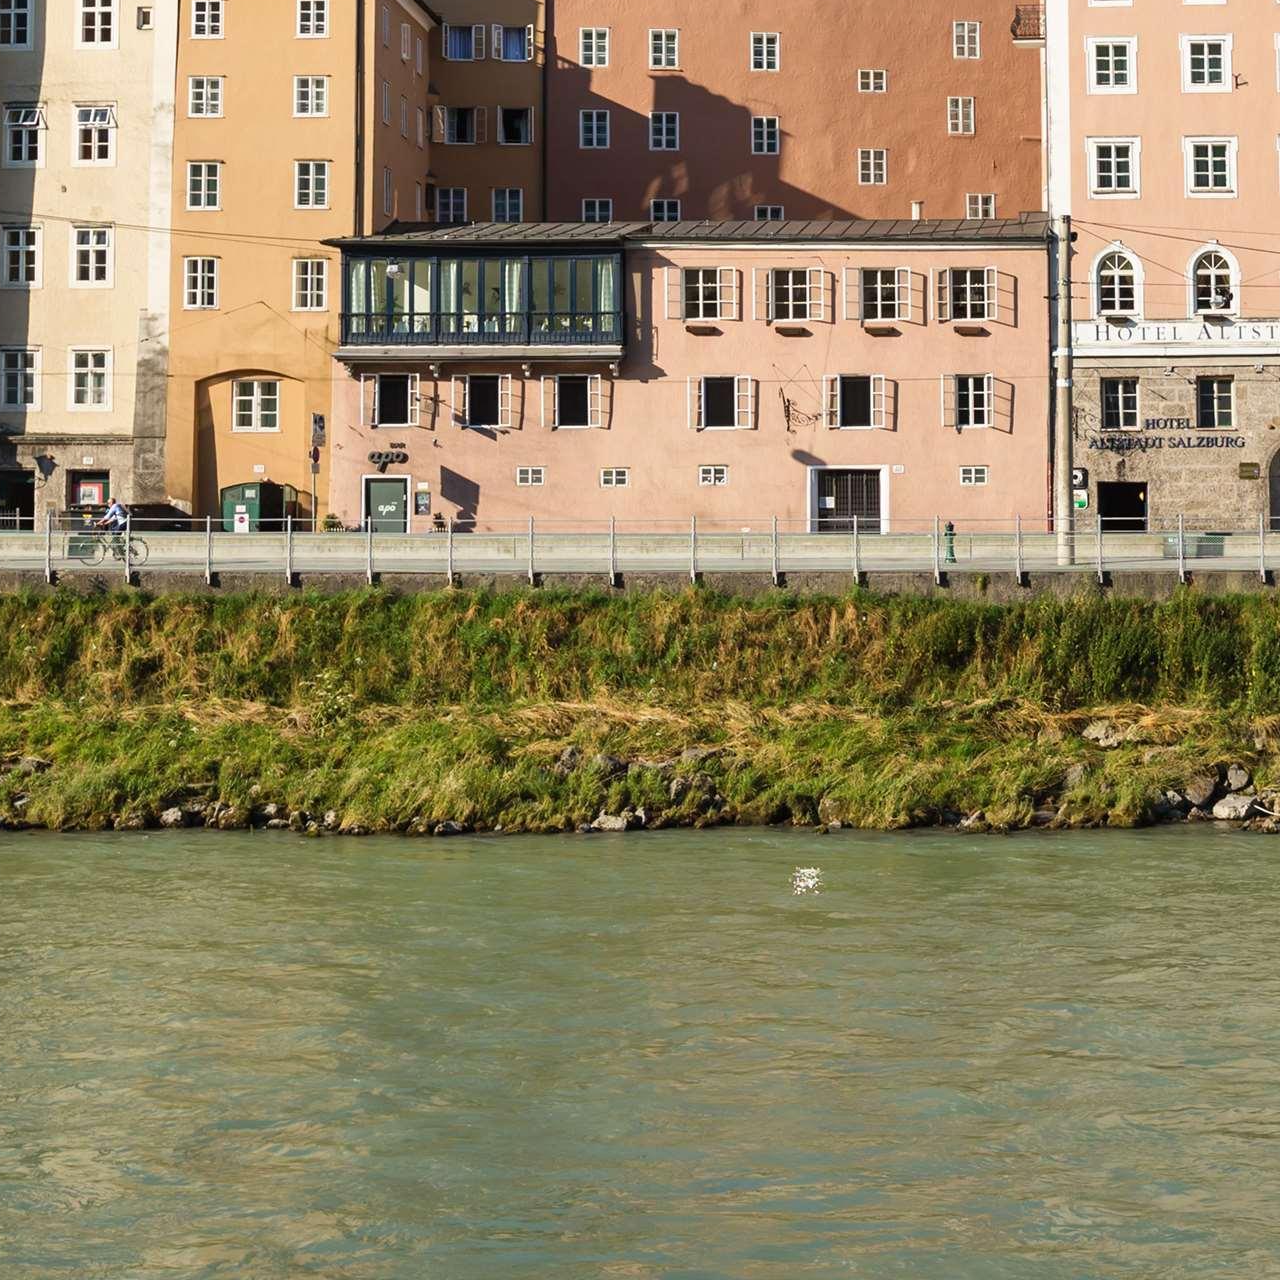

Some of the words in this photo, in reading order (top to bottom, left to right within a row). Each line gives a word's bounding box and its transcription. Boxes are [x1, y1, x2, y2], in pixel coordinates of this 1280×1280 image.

[1095, 324, 1182, 341] HOTEL
[1145, 418, 1195, 430] HOTEL
[1168, 436, 1246, 448] SALZBURG
